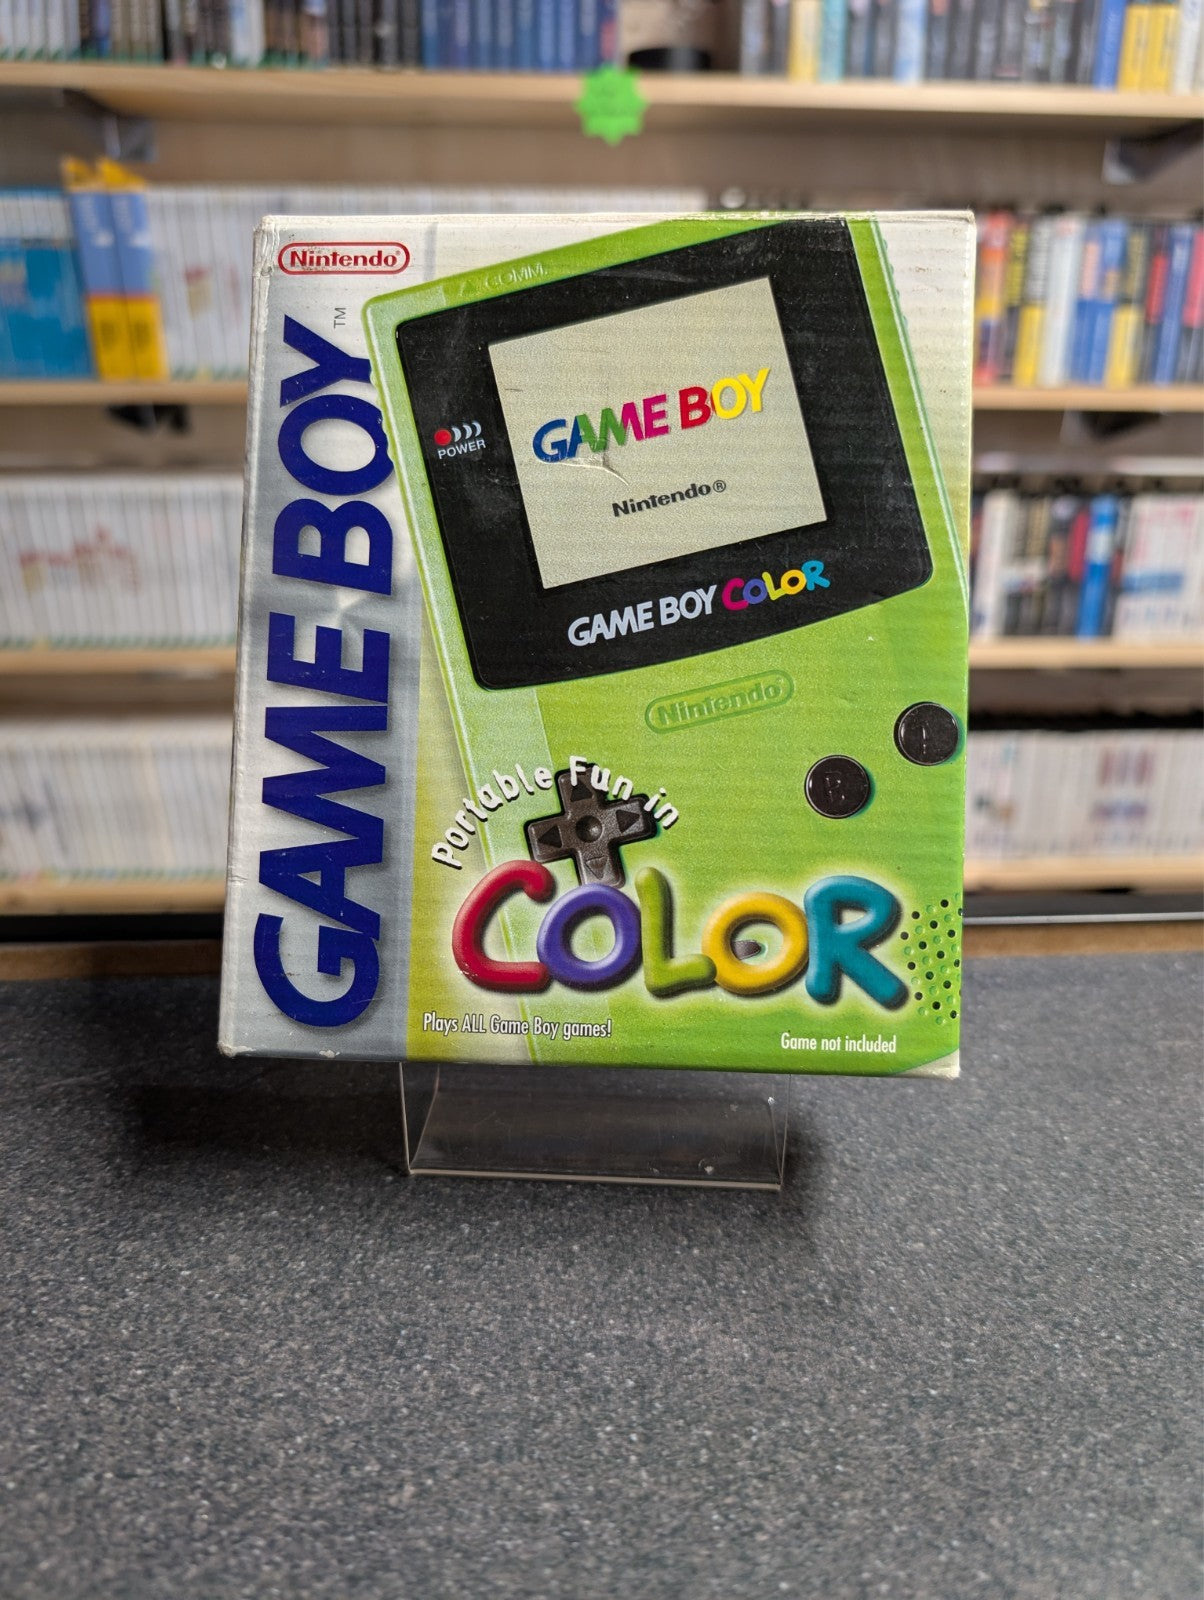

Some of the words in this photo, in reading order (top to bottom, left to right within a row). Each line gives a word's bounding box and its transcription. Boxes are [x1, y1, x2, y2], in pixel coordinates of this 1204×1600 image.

[272, 314, 394, 596] BOY
[437, 437, 487, 460] POWER
[532, 394, 670, 463] GAME
[678, 367, 771, 430] BOY
[567, 600, 654, 646] GAME
[659, 584, 718, 626] BOY
[721, 559, 831, 611] COLOR
[254, 611, 391, 1028] GAME
[431, 762, 554, 870] Portable
[569, 755, 634, 801] Fun
[644, 787, 680, 830] in
[452, 859, 909, 1010] COLOR
[423, 1011, 459, 1036] Plays
[461, 1013, 487, 1034] ALL
[489, 1014, 530, 1035] Game
[533, 1016, 560, 1040] Boy
[562, 1019, 613, 1042] games!
[780, 1032, 818, 1051] Game
[820, 1036, 842, 1052] not
[845, 1033, 898, 1054] included
